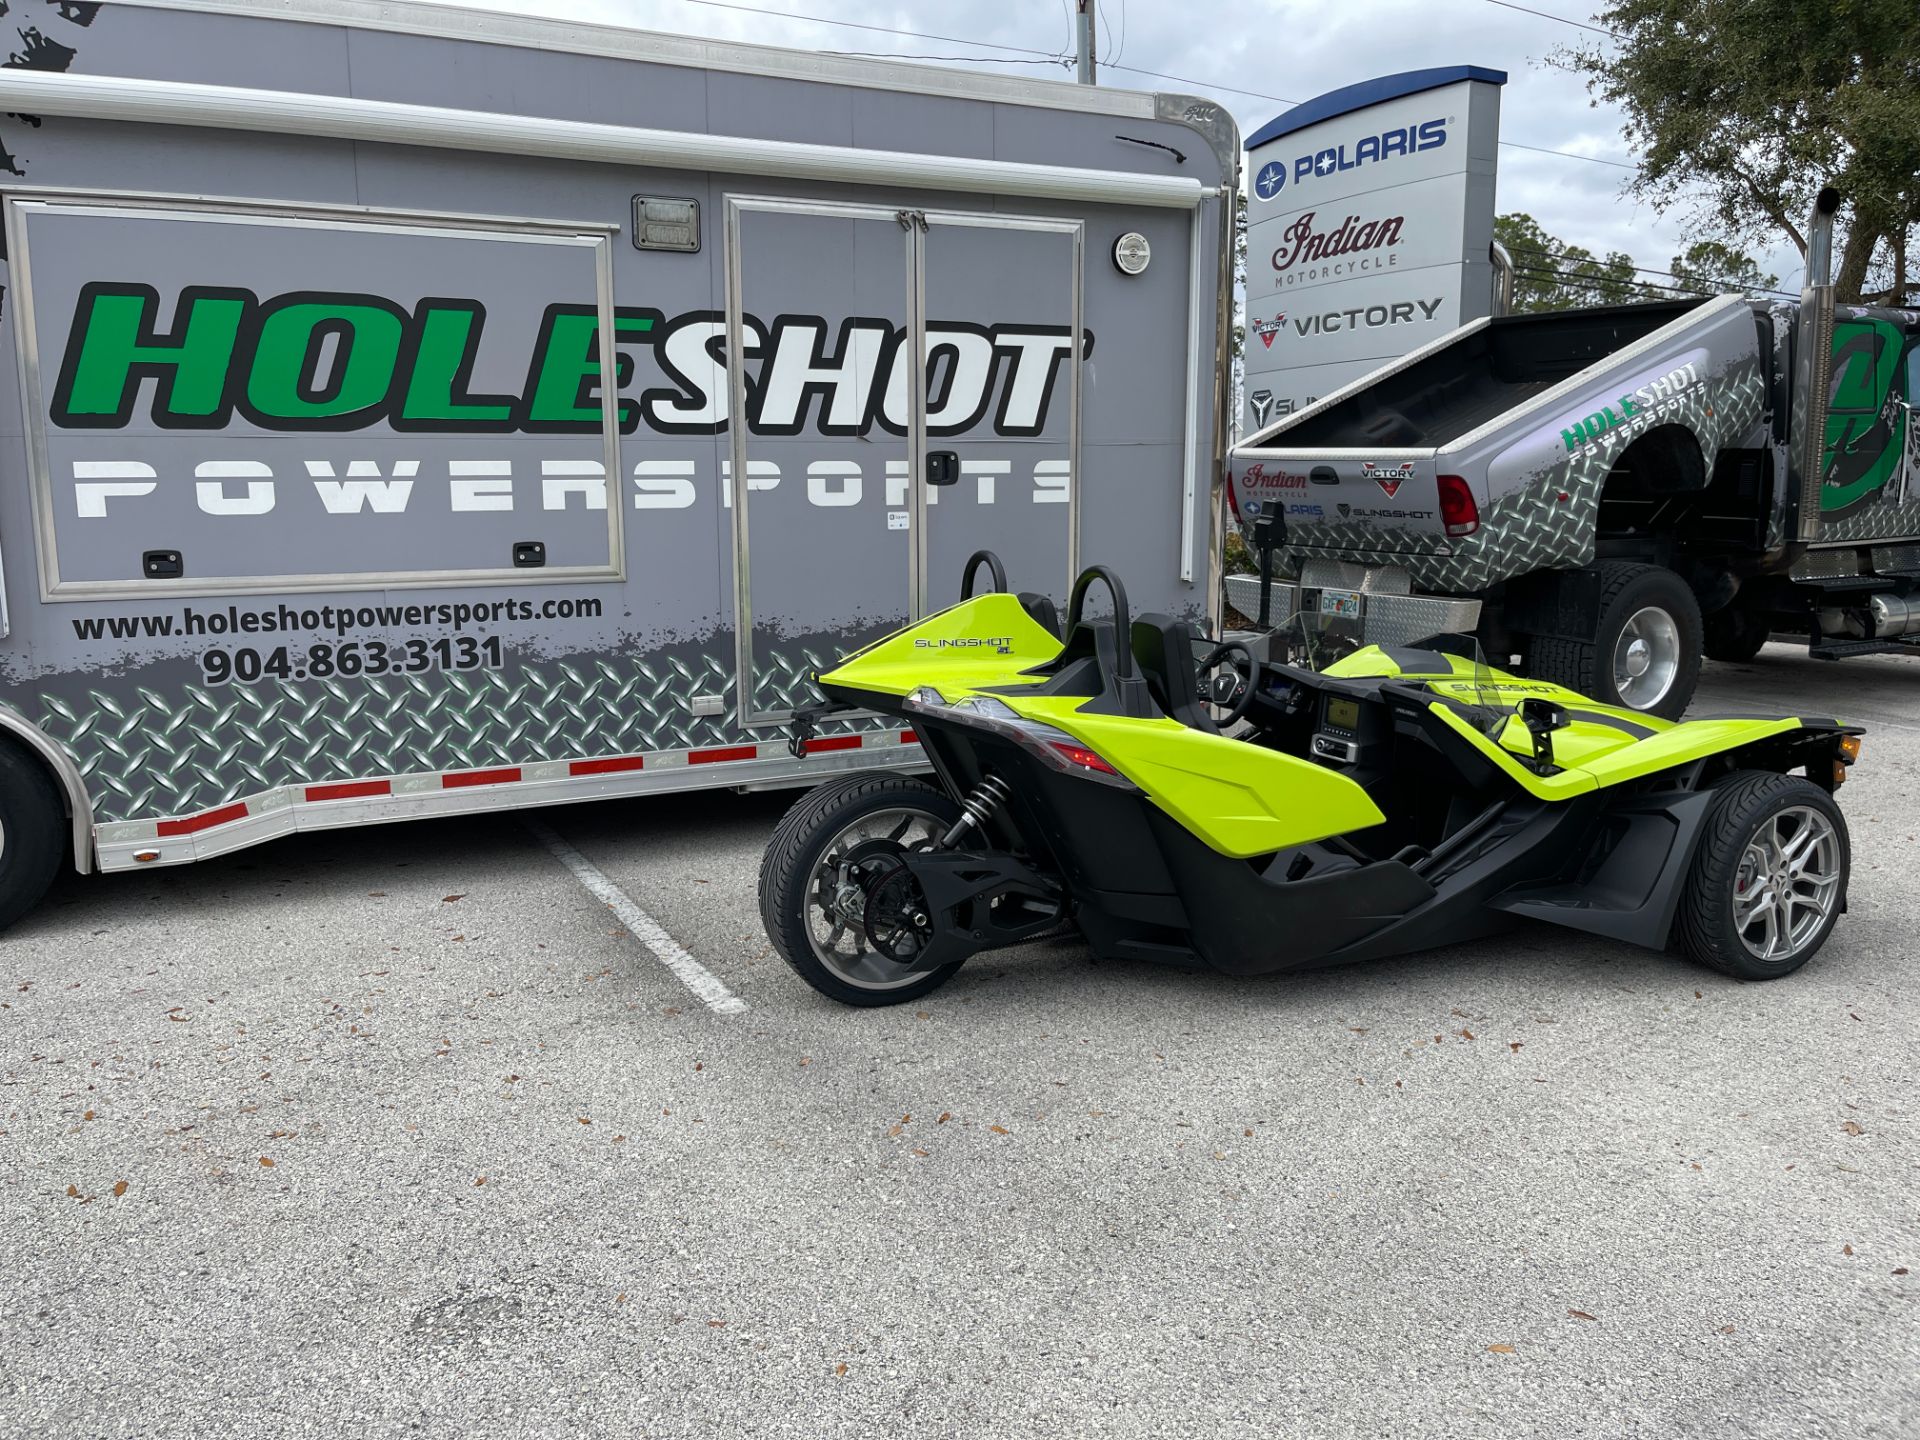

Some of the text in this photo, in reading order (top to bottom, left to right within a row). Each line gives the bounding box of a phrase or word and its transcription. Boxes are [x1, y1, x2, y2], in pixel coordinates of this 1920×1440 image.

[1294, 118, 1447, 184] POLARIS
[1271, 212, 1404, 271] Indian
[1274, 253, 1397, 288] MOTORCYCLE
[1252, 318, 1288, 333] VICTORY
[1294, 297, 1445, 337] VICTORY
[50, 281, 1094, 436] HOLESHOT
[1560, 361, 1698, 451] HOLESHOT
[1568, 382, 1706, 466] POWERSPORTS
[1242, 463, 1307, 488] Indian
[1361, 469, 1415, 478] VICTORY
[1283, 504, 1324, 515] LARIS
[1352, 508, 1434, 519] SLINGSHOT
[71, 597, 602, 640] www.holeshotpowersports.com
[203, 635, 503, 684] 904.863.3131
[914, 637, 1014, 648] SLINGSHOT
[1450, 683, 1559, 694] SLINGSHOT
